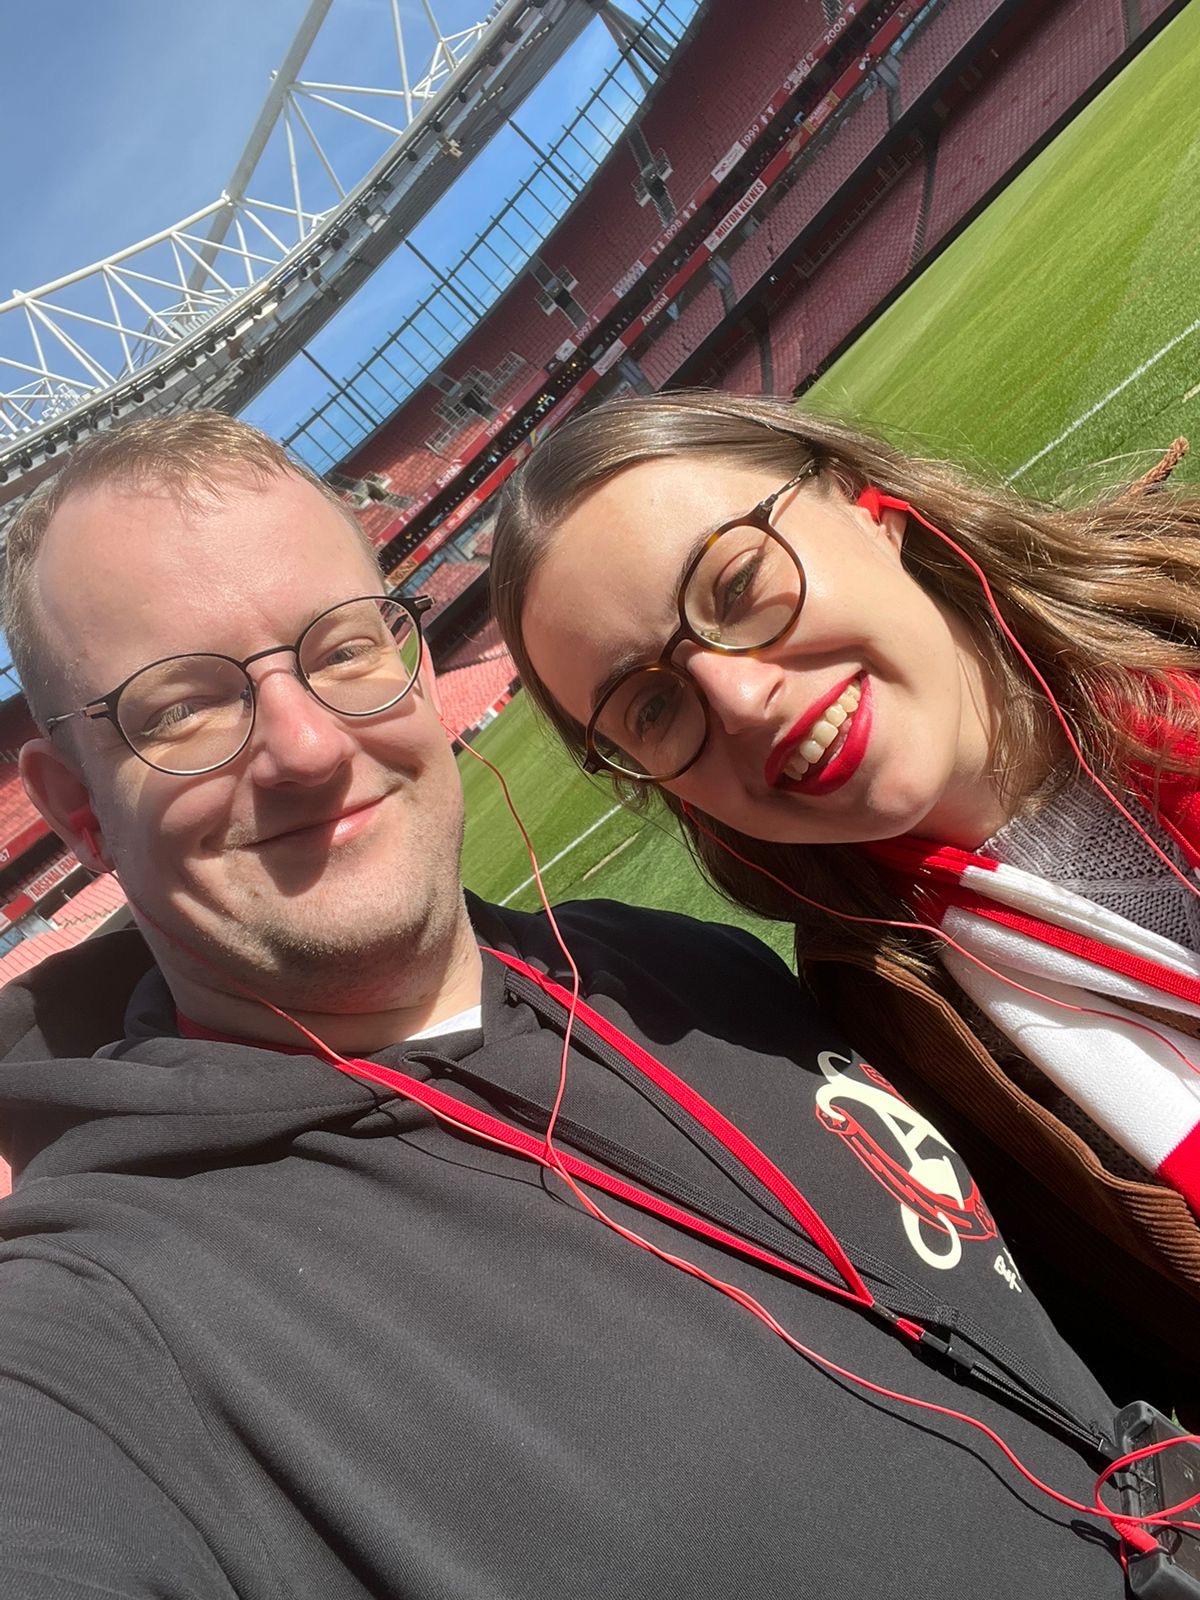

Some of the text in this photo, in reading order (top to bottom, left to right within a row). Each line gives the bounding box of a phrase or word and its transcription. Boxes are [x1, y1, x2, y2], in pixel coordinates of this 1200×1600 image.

[823, 17, 847, 45] 2000
[741, 125, 760, 147] 1999
[715, 182, 765, 239] MILTON KEYNES
[664, 220, 683, 241] 1998
[641, 294, 668, 326] Arsenal
[575, 322, 593, 342] 1997
[486, 417, 504, 438] 1995
[31, 866, 63, 897] ARSENAL
